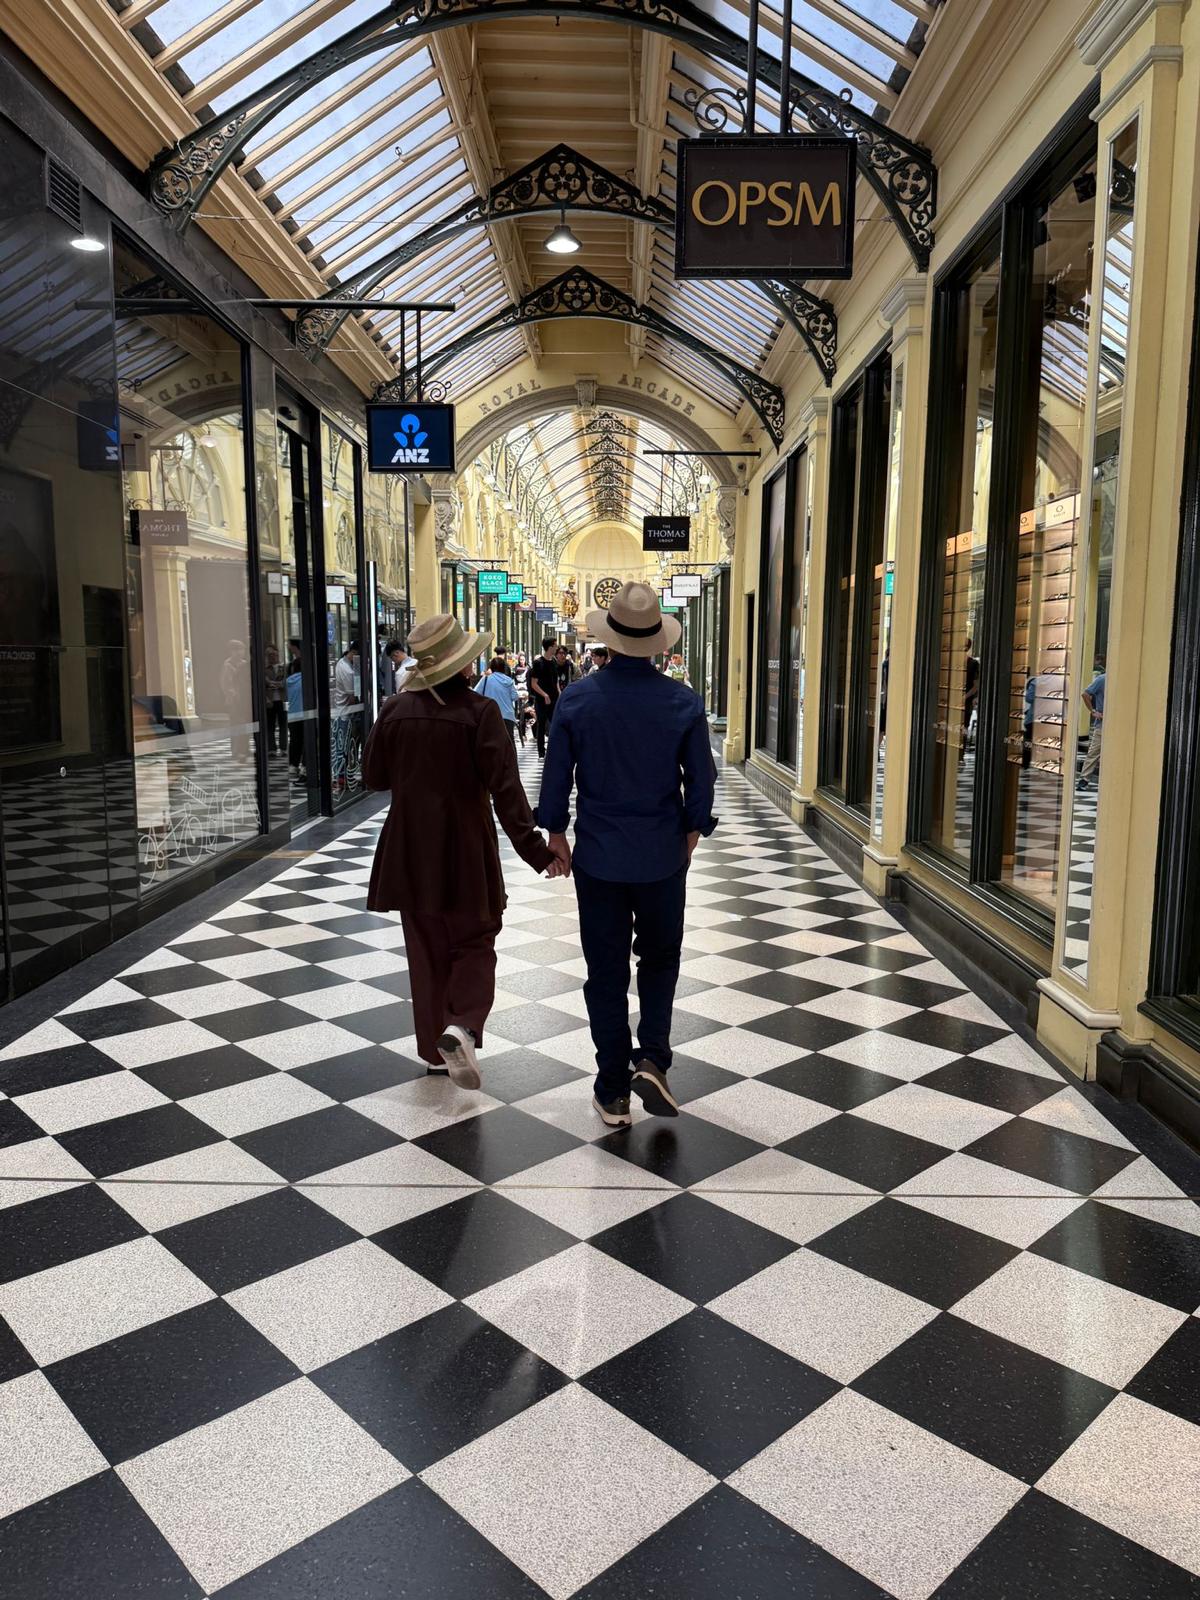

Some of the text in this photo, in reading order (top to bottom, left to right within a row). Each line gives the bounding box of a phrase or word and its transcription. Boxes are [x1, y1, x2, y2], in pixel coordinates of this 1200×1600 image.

[691, 180, 842, 227] OPSM
[478, 373, 697, 417] ROYAL ARCADE
[391, 448, 430, 463] ANZ
[647, 530, 686, 538] THOMAS
